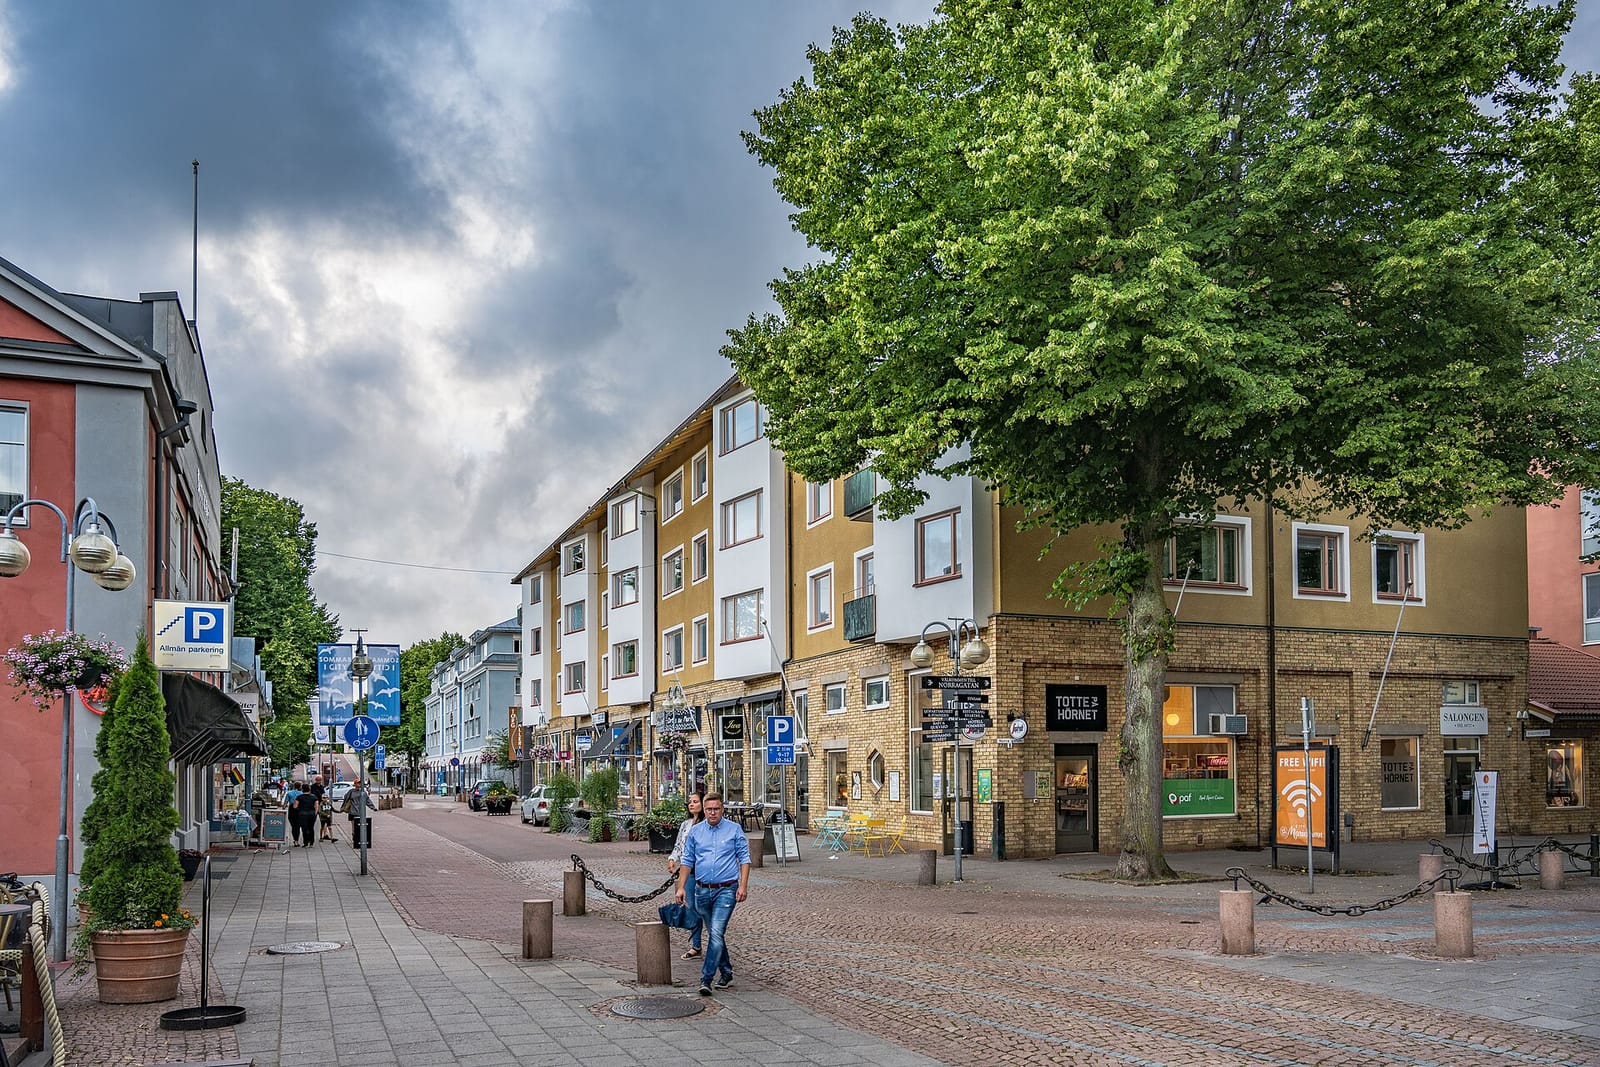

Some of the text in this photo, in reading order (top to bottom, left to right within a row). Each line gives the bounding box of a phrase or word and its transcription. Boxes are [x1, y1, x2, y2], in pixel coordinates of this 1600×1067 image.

[192, 611, 217, 640] P
[160, 644, 224, 655] Allmän parkering
[329, 663, 346, 671] CITY
[1056, 696, 1090, 708] TOTTE
[1057, 707, 1098, 720] HÖRNET
[1443, 712, 1485, 721] SALONGEN
[774, 718, 790, 742] P
[1279, 757, 1300, 768] FREE
[1382, 762, 1408, 772] TOTTE
[1178, 793, 1192, 805] paf
